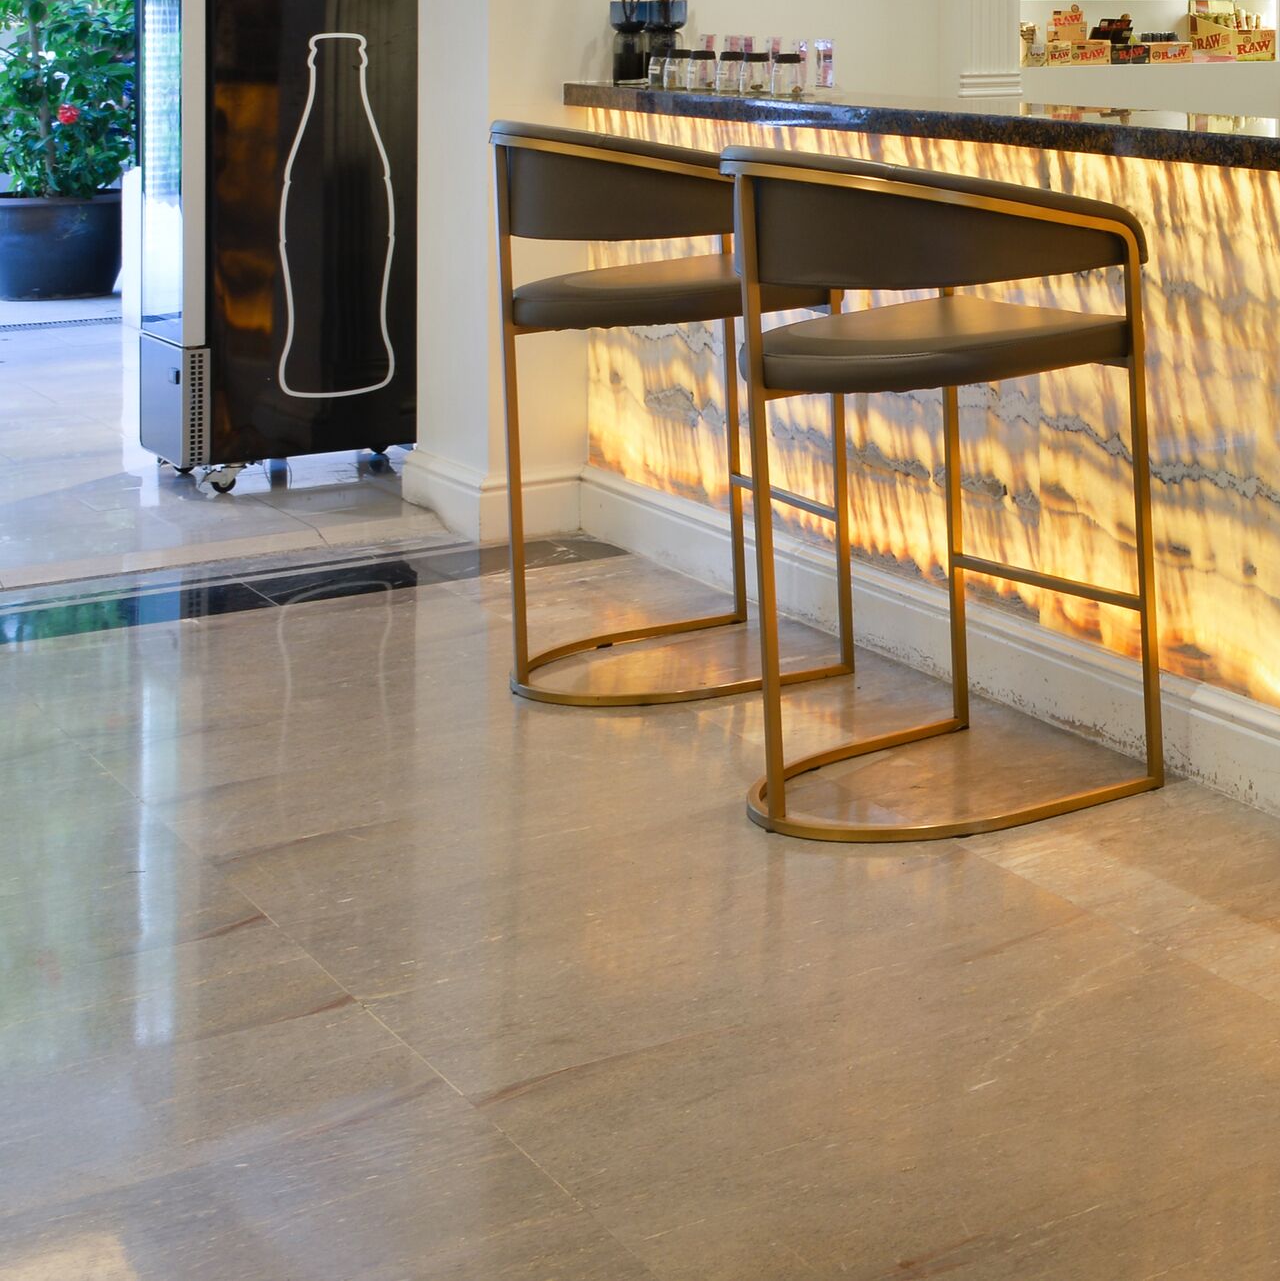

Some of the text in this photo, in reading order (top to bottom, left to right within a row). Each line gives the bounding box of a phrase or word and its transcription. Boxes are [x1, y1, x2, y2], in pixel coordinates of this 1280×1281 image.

[1198, 32, 1221, 50] RAW
[1237, 40, 1271, 55] RAW
[1050, 50, 1071, 60] RAW
[1080, 47, 1106, 61] RAW
[1119, 46, 1145, 60] RAW
